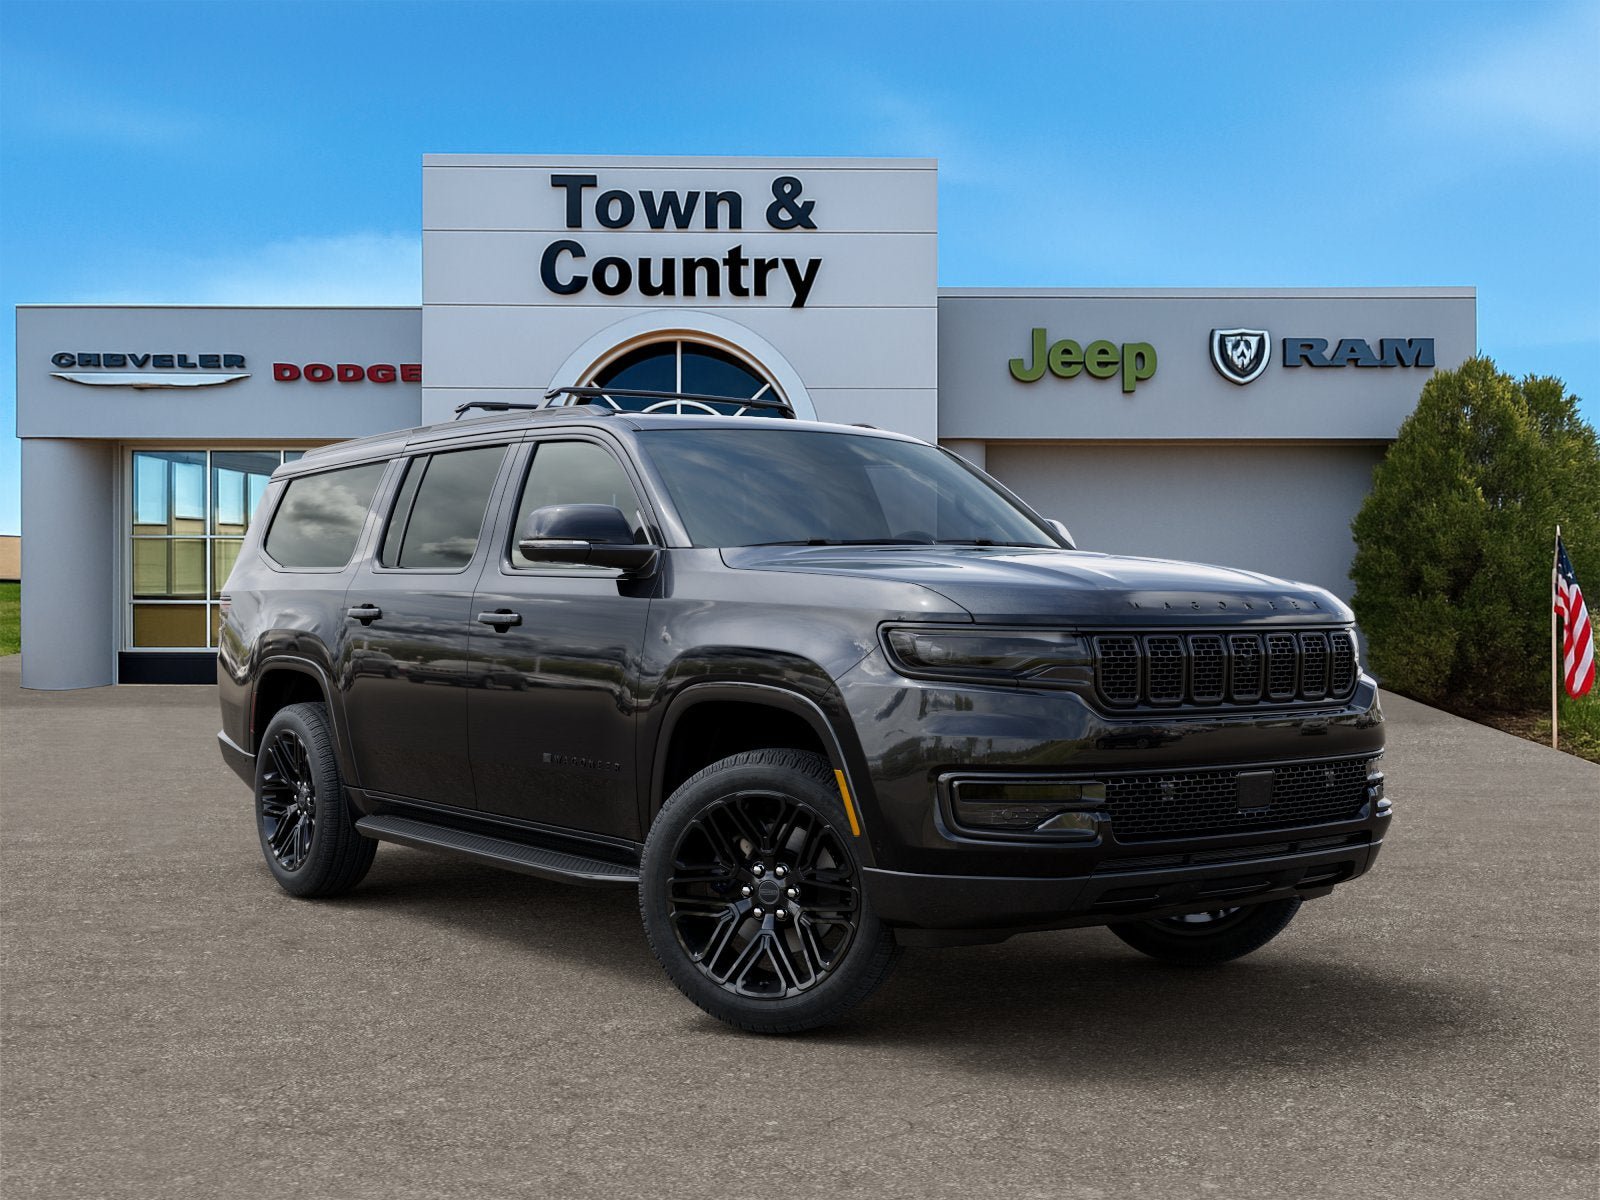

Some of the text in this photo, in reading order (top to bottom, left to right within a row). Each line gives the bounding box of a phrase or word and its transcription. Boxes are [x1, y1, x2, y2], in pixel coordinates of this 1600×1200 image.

[551, 174, 818, 230] Town &
[540, 239, 822, 308] Country
[272, 363, 422, 382] DODGE
[1008, 328, 1158, 393] Jeep
[1283, 338, 1436, 368] RAM
